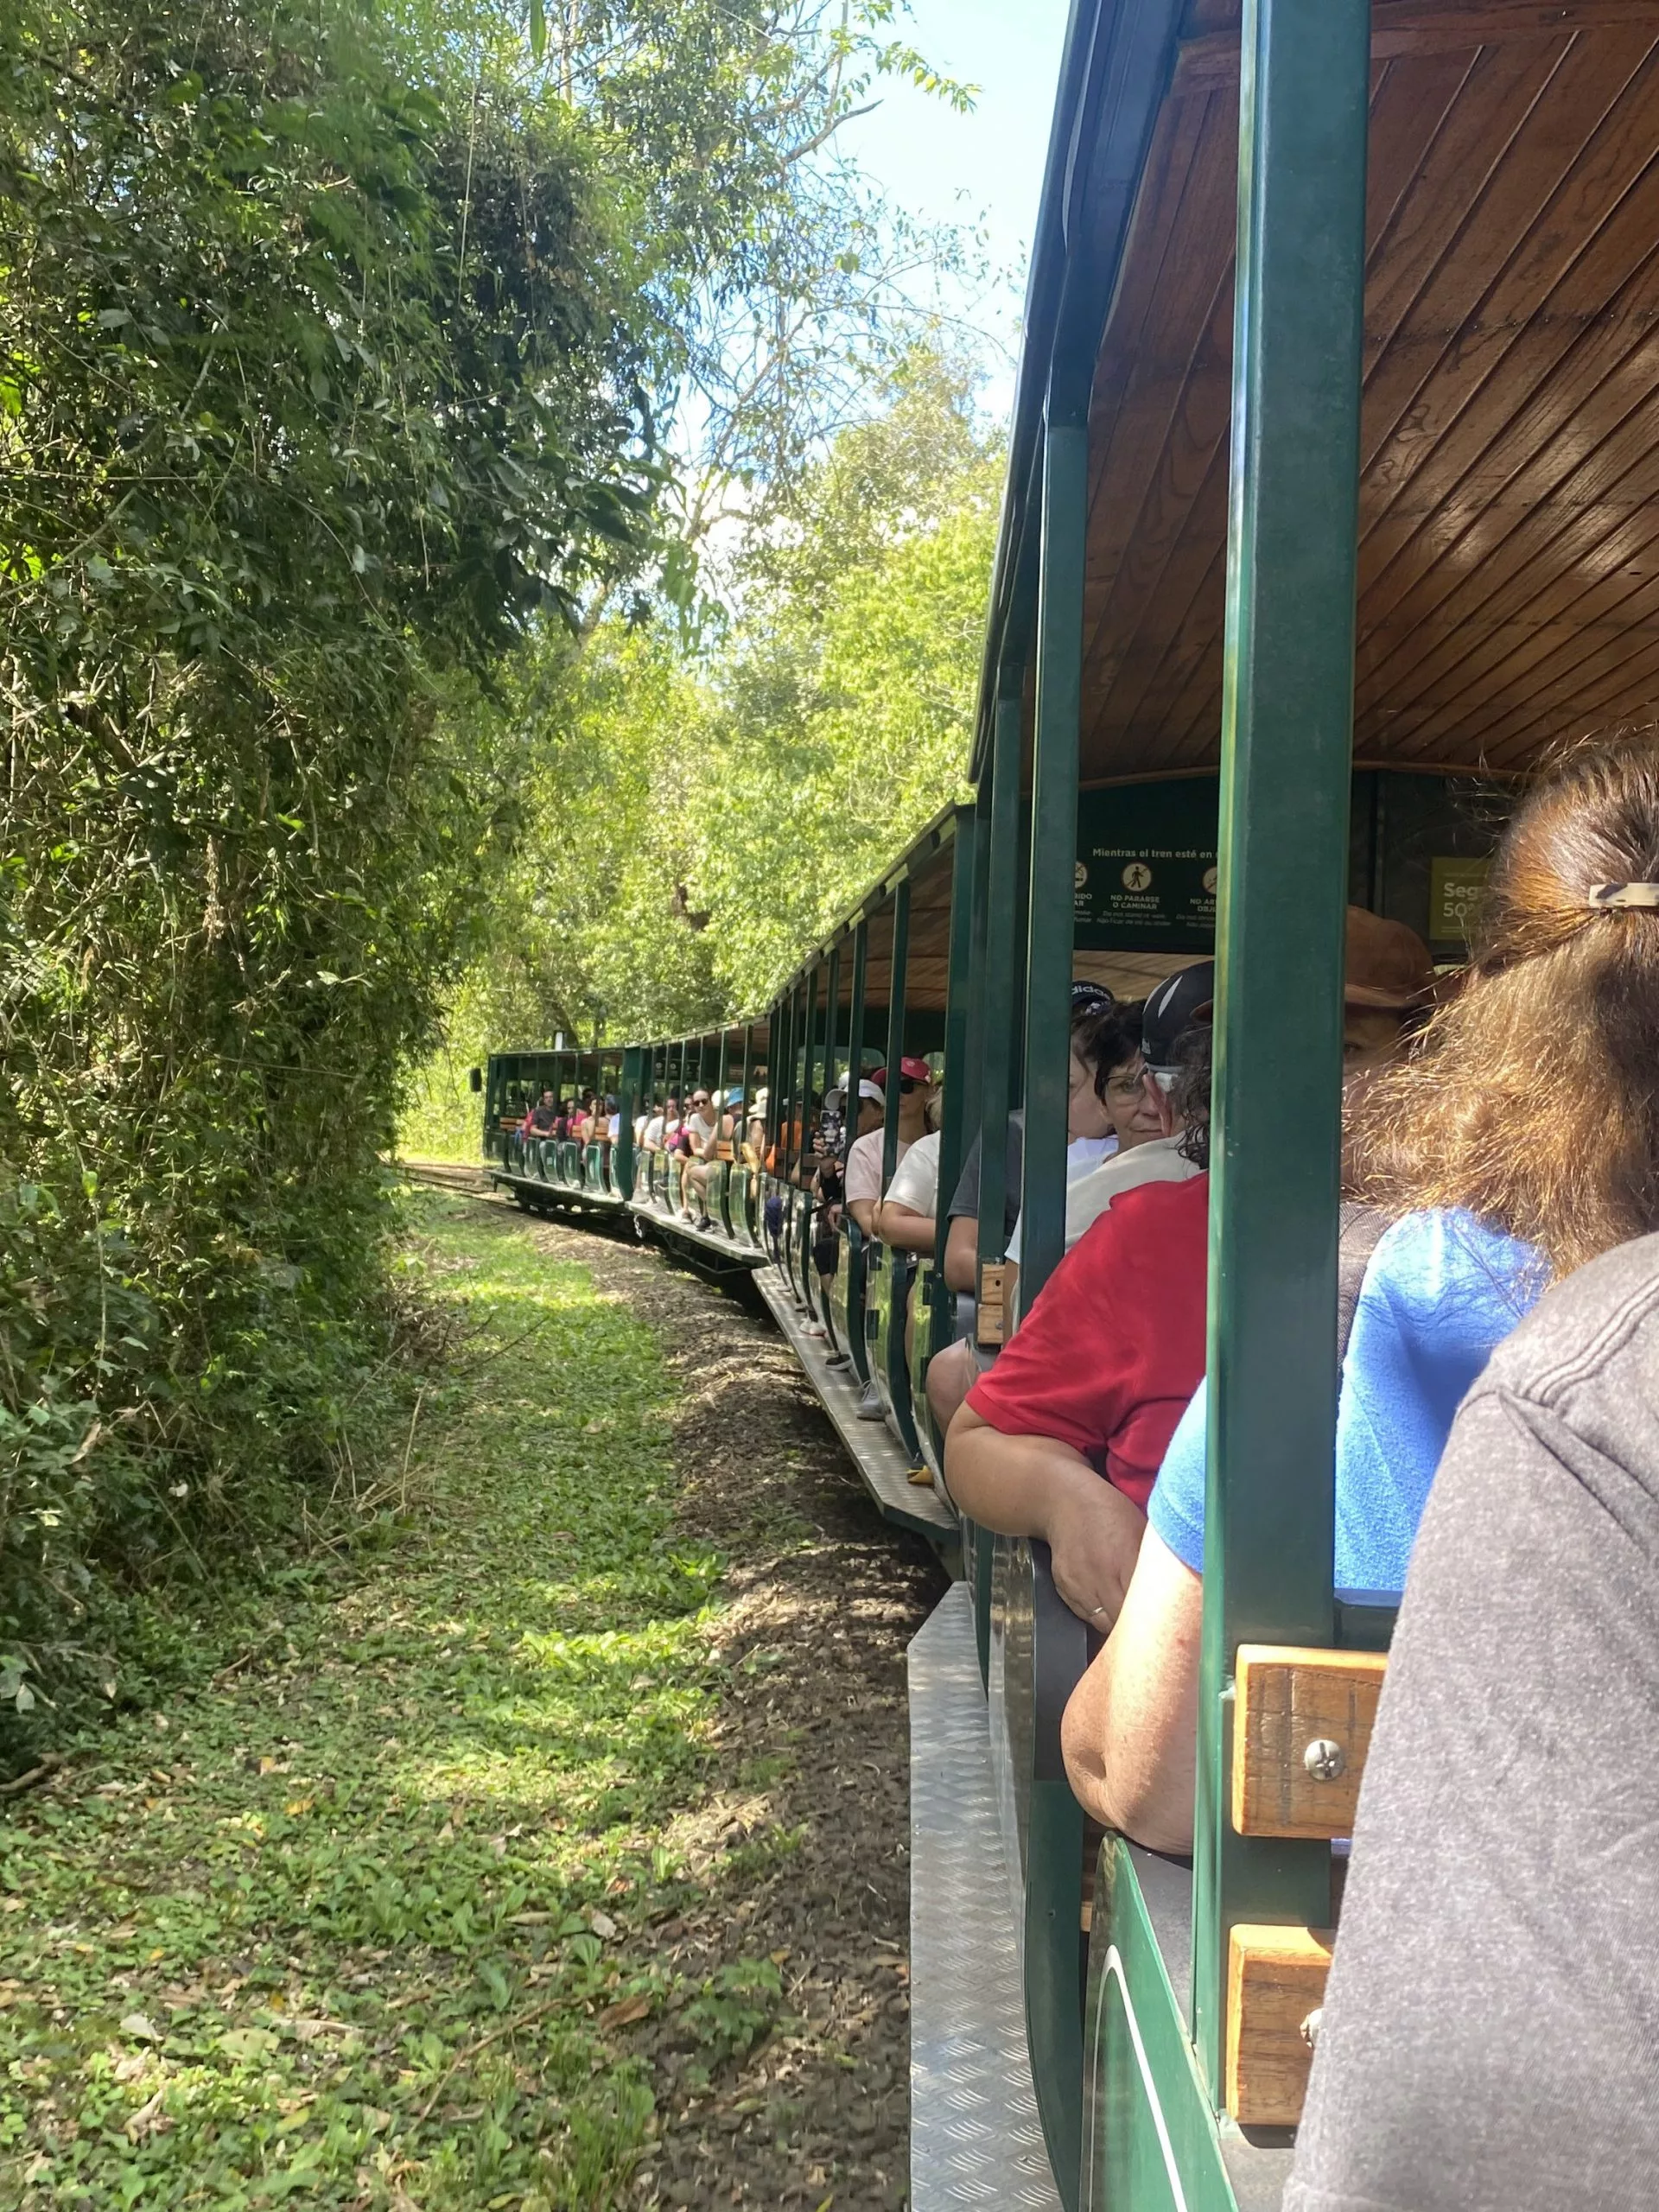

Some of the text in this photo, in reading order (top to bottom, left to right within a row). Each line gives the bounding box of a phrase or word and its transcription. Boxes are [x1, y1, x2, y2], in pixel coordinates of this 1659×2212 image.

[1093, 848, 1135, 857] Mientras
[1139, 849, 1148, 858] el
[1175, 849, 1197, 859] esté
[1444, 882, 1478, 901] Seg
